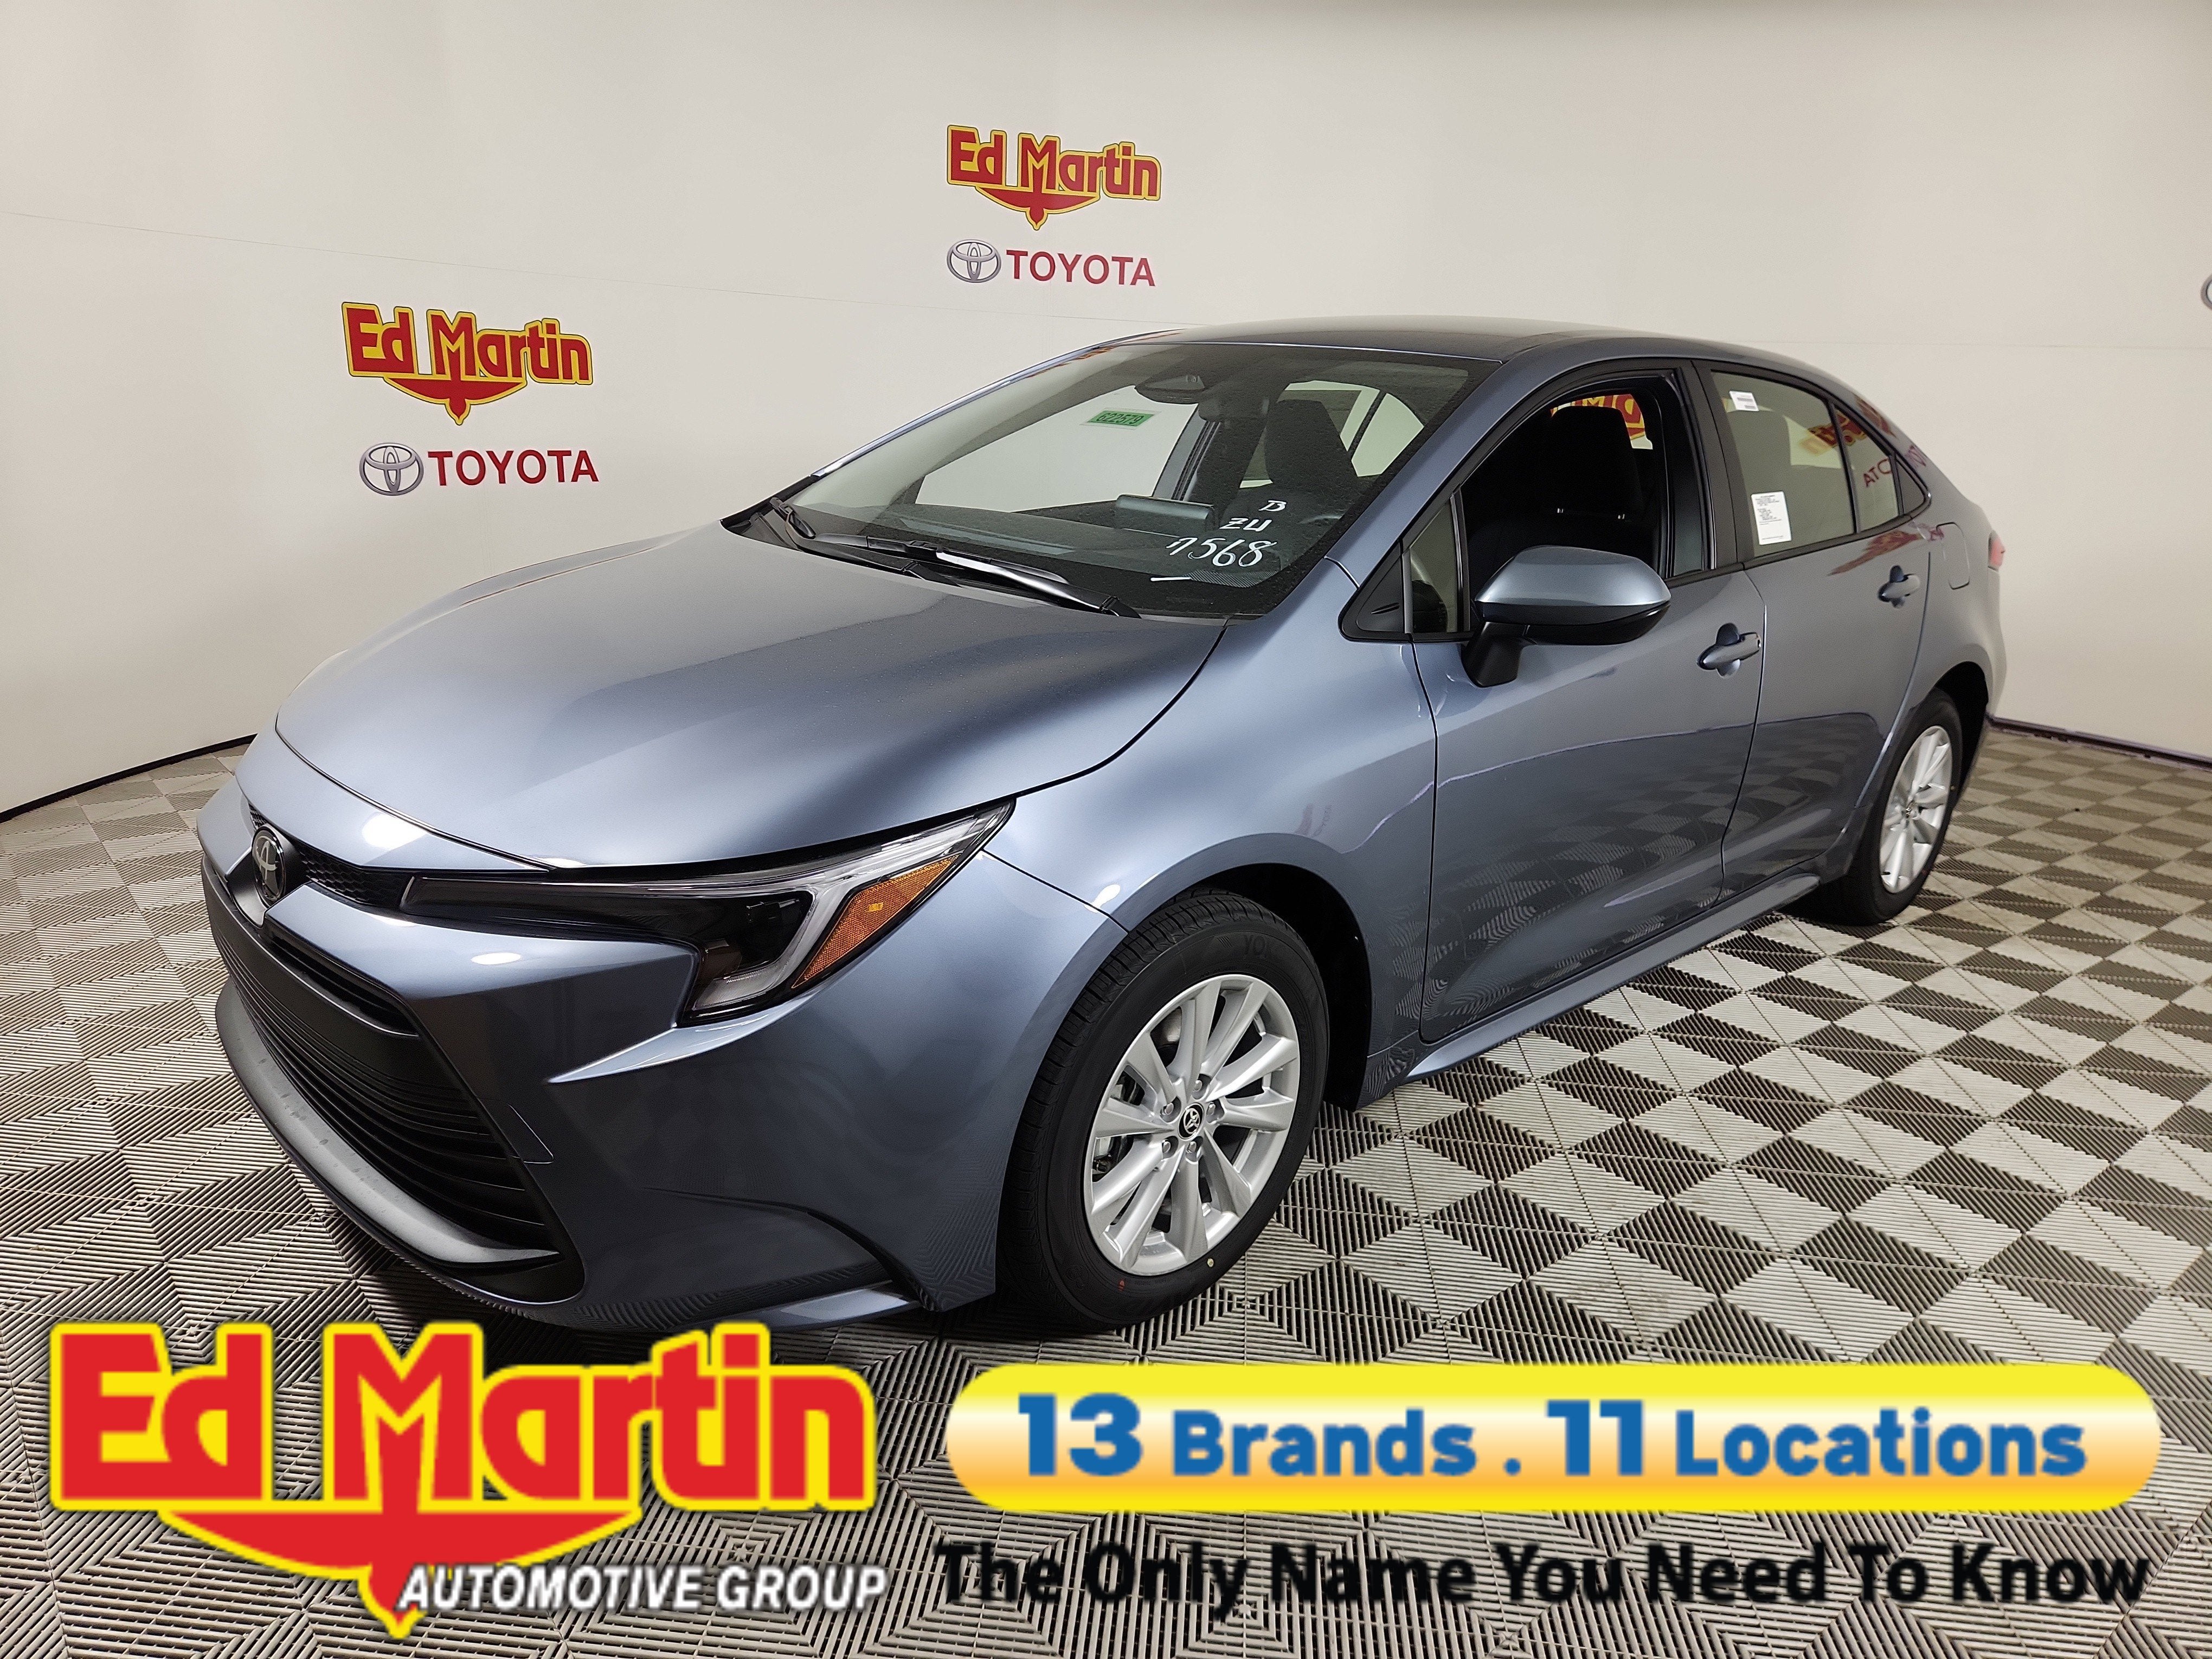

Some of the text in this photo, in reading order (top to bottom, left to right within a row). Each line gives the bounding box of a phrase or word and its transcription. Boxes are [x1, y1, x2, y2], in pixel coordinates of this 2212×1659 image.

[947, 125, 1161, 201] Ed Martin
[1006, 250, 1155, 286] TOYOTA
[342, 302, 593, 385] Ed Martin
[1096, 413, 1144, 425] 622579
[428, 449, 599, 486] TOYOTA
